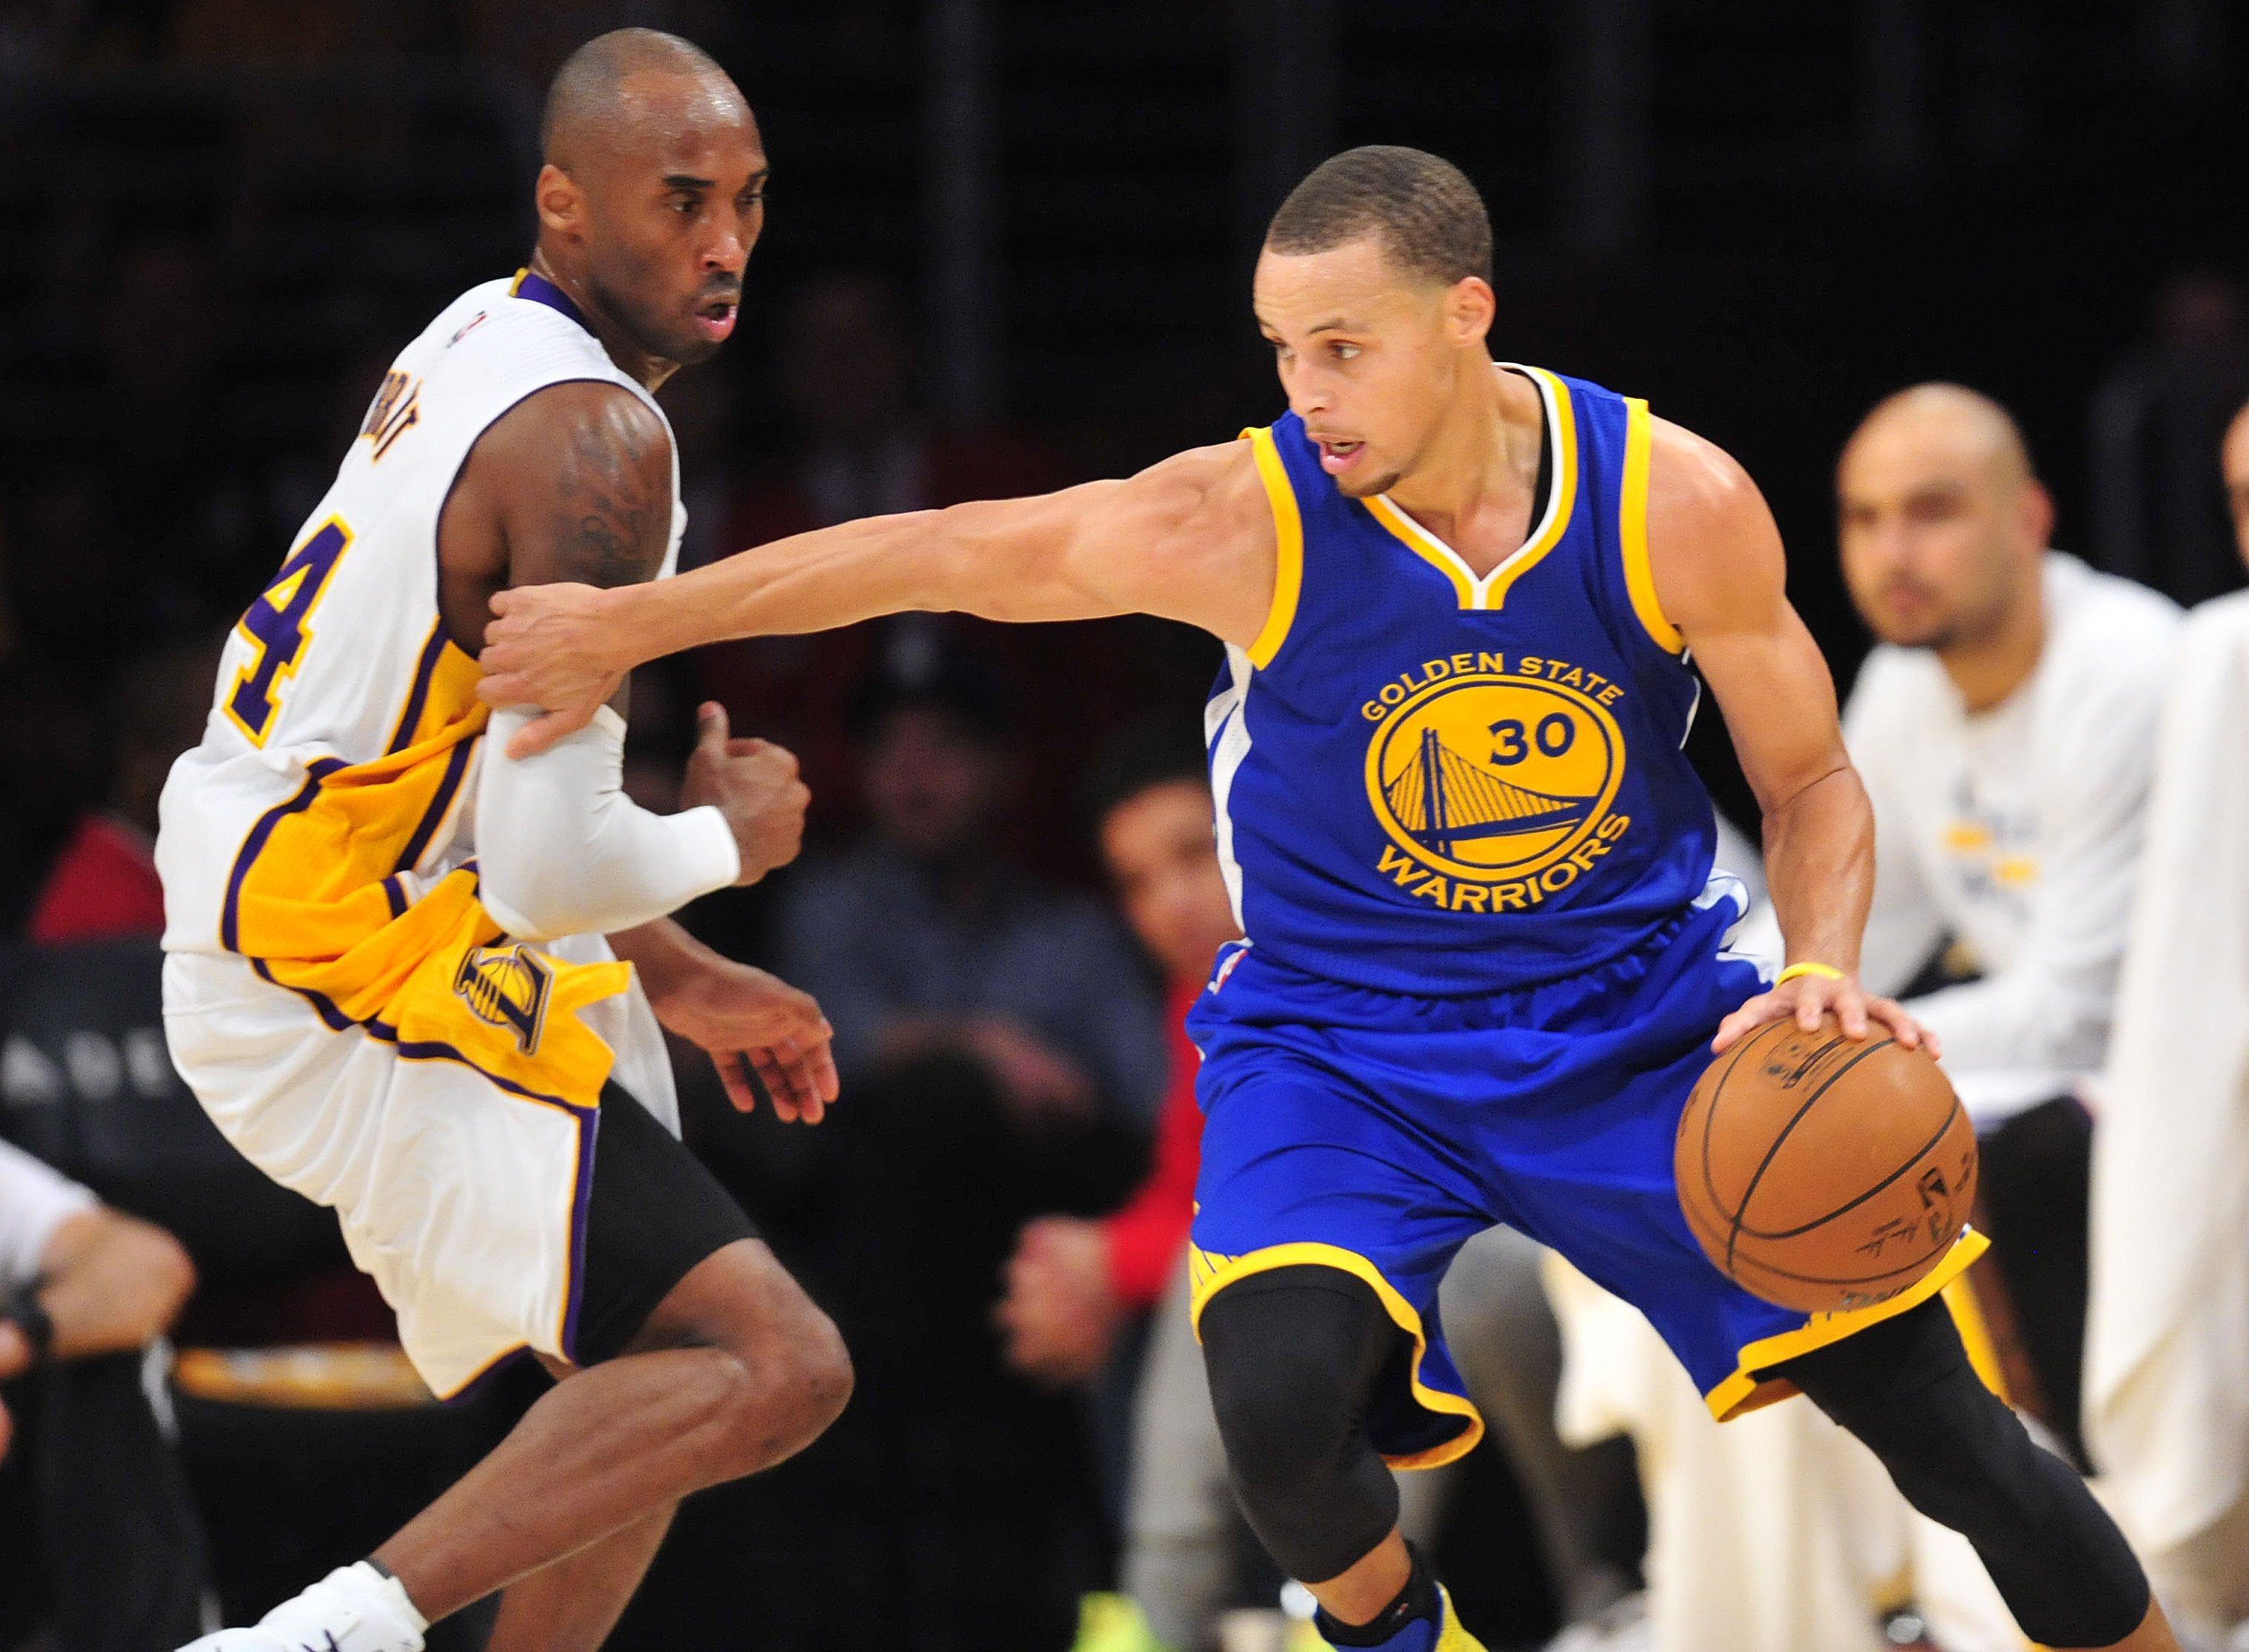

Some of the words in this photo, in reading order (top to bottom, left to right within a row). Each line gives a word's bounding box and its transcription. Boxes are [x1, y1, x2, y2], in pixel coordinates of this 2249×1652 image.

[1361, 652, 1505, 722] GOLDEN
[1518, 655, 1625, 707] STATE
[1487, 711, 1576, 767] 30
[1375, 813, 1631, 914] WARRIORS
